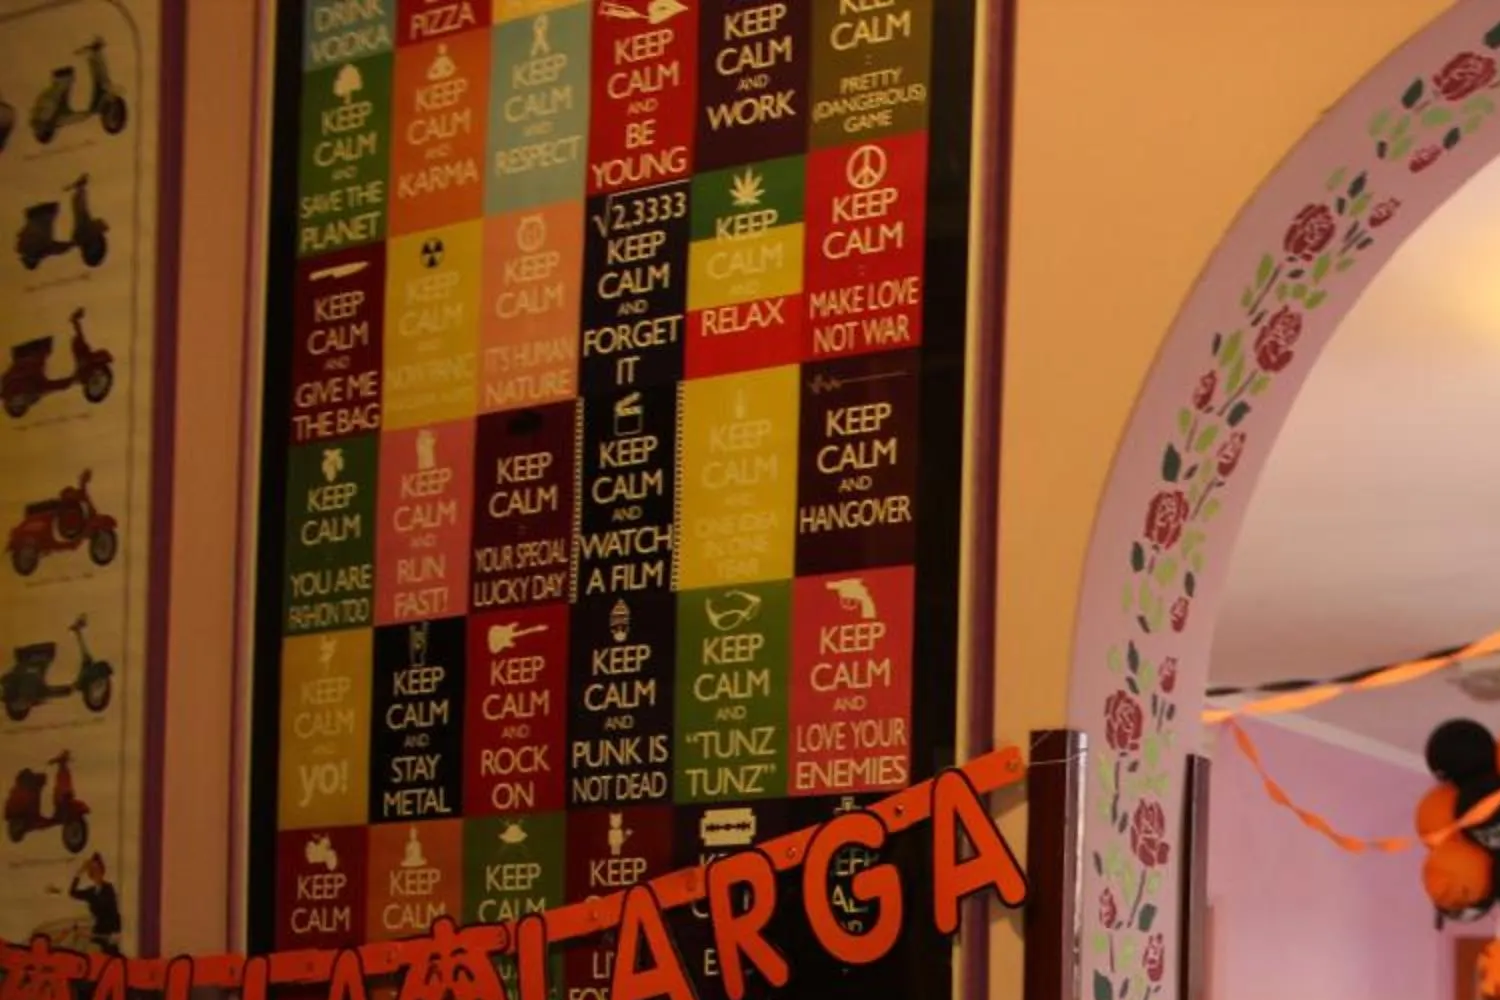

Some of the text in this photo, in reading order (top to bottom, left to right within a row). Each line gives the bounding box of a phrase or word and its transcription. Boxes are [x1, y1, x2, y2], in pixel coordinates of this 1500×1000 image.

[409, 3, 475, 39] PIZZA
[724, 3, 787, 40] KEEP
[830, 10, 911, 51] CALM
[615, 29, 674, 64] KEEP
[716, 36, 792, 75] CALM
[512, 53, 568, 89] KEEP
[607, 60, 679, 98] CALM
[737, 74, 770, 92] AND
[841, 67, 903, 94] PRETTY
[416, 78, 467, 112] KEEP
[504, 85, 573, 122] CALM
[627, 98, 659, 115] AND
[706, 90, 796, 131] WORK
[812, 83, 927, 123] (DANGEROUS)
[322, 101, 372, 136] KEEP
[407, 108, 471, 145] CALM
[625, 119, 657, 149] BE
[843, 109, 893, 133] GAME
[313, 132, 377, 166] CALM
[496, 135, 583, 175] RESPECT
[397, 158, 479, 199] KARMA
[592, 146, 688, 189] YOUNG
[301, 181, 383, 218] SAVE THE
[832, 187, 898, 224] KEEP
[301, 211, 382, 252] PLANET
[715, 209, 778, 241] KEEP
[822, 221, 904, 259] CALM
[607, 230, 667, 264] KEEP
[707, 243, 783, 279] CALM
[504, 250, 560, 285] KEEP
[598, 261, 670, 300] CALM
[314, 290, 365, 322] KEEP
[496, 281, 564, 319] CALM
[617, 299, 649, 317] AND
[809, 276, 920, 320] MAKE LOVE
[701, 298, 785, 337] RELAX
[813, 314, 911, 353] NOT WAR
[307, 321, 369, 355] CALM
[583, 314, 684, 357] FORGET
[616, 355, 640, 385] IT
[295, 377, 343, 408] GIVE
[346, 370, 379, 401] ME
[485, 369, 574, 407] NATURE
[292, 402, 380, 440] THE BAG
[709, 419, 773, 454] KEEP
[825, 402, 892, 438] KEEP
[496, 451, 553, 485] KEEP
[599, 435, 658, 469] KEEP
[817, 437, 897, 474] CALM
[401, 467, 453, 499] KEEP
[591, 468, 663, 505] CALM
[701, 454, 778, 490] CALM
[838, 475, 873, 492] AND
[307, 482, 358, 513] KEEP
[488, 484, 558, 519] CALM
[612, 504, 644, 521] AND
[799, 495, 912, 534] HANGOVER
[301, 513, 361, 546] CALM
[393, 500, 457, 532] CALM
[475, 538, 569, 573] YOUR SPECIAL
[580, 523, 673, 559] WATCH
[291, 563, 373, 598] YOU ARE
[397, 554, 446, 584] RUN
[585, 560, 664, 595] A FILM
[394, 587, 449, 619] FAST!
[473, 571, 567, 607] LUCKY DAY
[703, 633, 764, 665] KEEP
[820, 621, 886, 655] KEEP
[490, 655, 546, 686] KEEP
[592, 644, 651, 676] KEEP
[810, 657, 892, 692] CALM
[301, 676, 351, 705] KEEP
[393, 666, 445, 697] KEEP
[583, 678, 656, 711] CALM
[693, 668, 771, 702] CALM
[385, 699, 449, 730] CALM
[482, 689, 550, 720] CALM
[716, 705, 747, 720] AND
[833, 695, 867, 712] AND
[293, 707, 355, 739] CALM
[501, 724, 531, 739] AND
[604, 715, 635, 731] AND
[797, 717, 907, 753] LOVE YOUR
[390, 753, 442, 783] STAY
[480, 745, 551, 777] ROCK
[572, 735, 669, 769] PUNK IS
[299, 758, 349, 809] yo!
[572, 771, 668, 804] NOT DEAD
[796, 755, 908, 790] ENEMIES
[383, 786, 452, 817] METAL
[491, 781, 536, 810] ON
[297, 872, 348, 900] KEEP
[389, 868, 441, 896] KEEP
[485, 863, 541, 893] KEEP
[589, 857, 648, 887] KEEP
[290, 906, 351, 934] CALM
[382, 902, 446, 930] CALM
[478, 897, 547, 924] CALM
